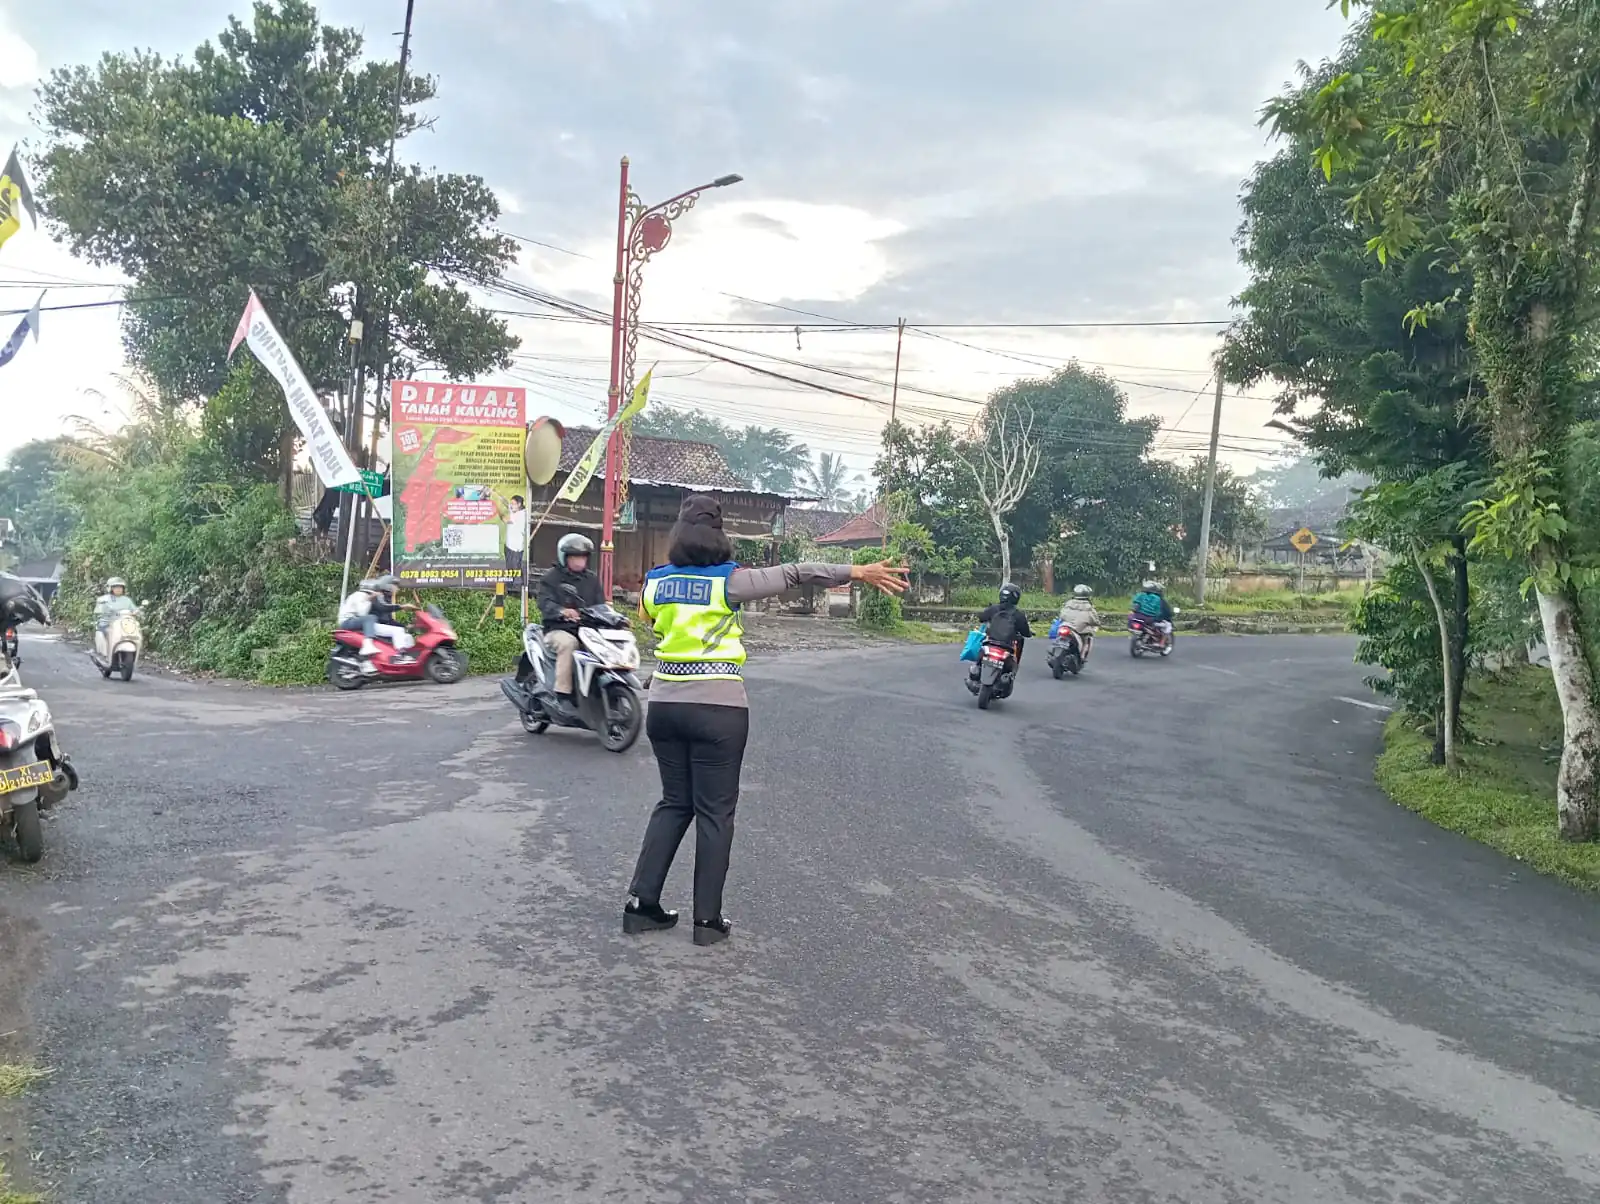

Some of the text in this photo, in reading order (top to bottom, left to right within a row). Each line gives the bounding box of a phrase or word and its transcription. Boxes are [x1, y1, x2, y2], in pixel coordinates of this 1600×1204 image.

[401, 385, 517, 407] DIJUAL
[400, 403, 518, 419] TANAH KAVLING
[655, 580, 710, 601] POLISI
